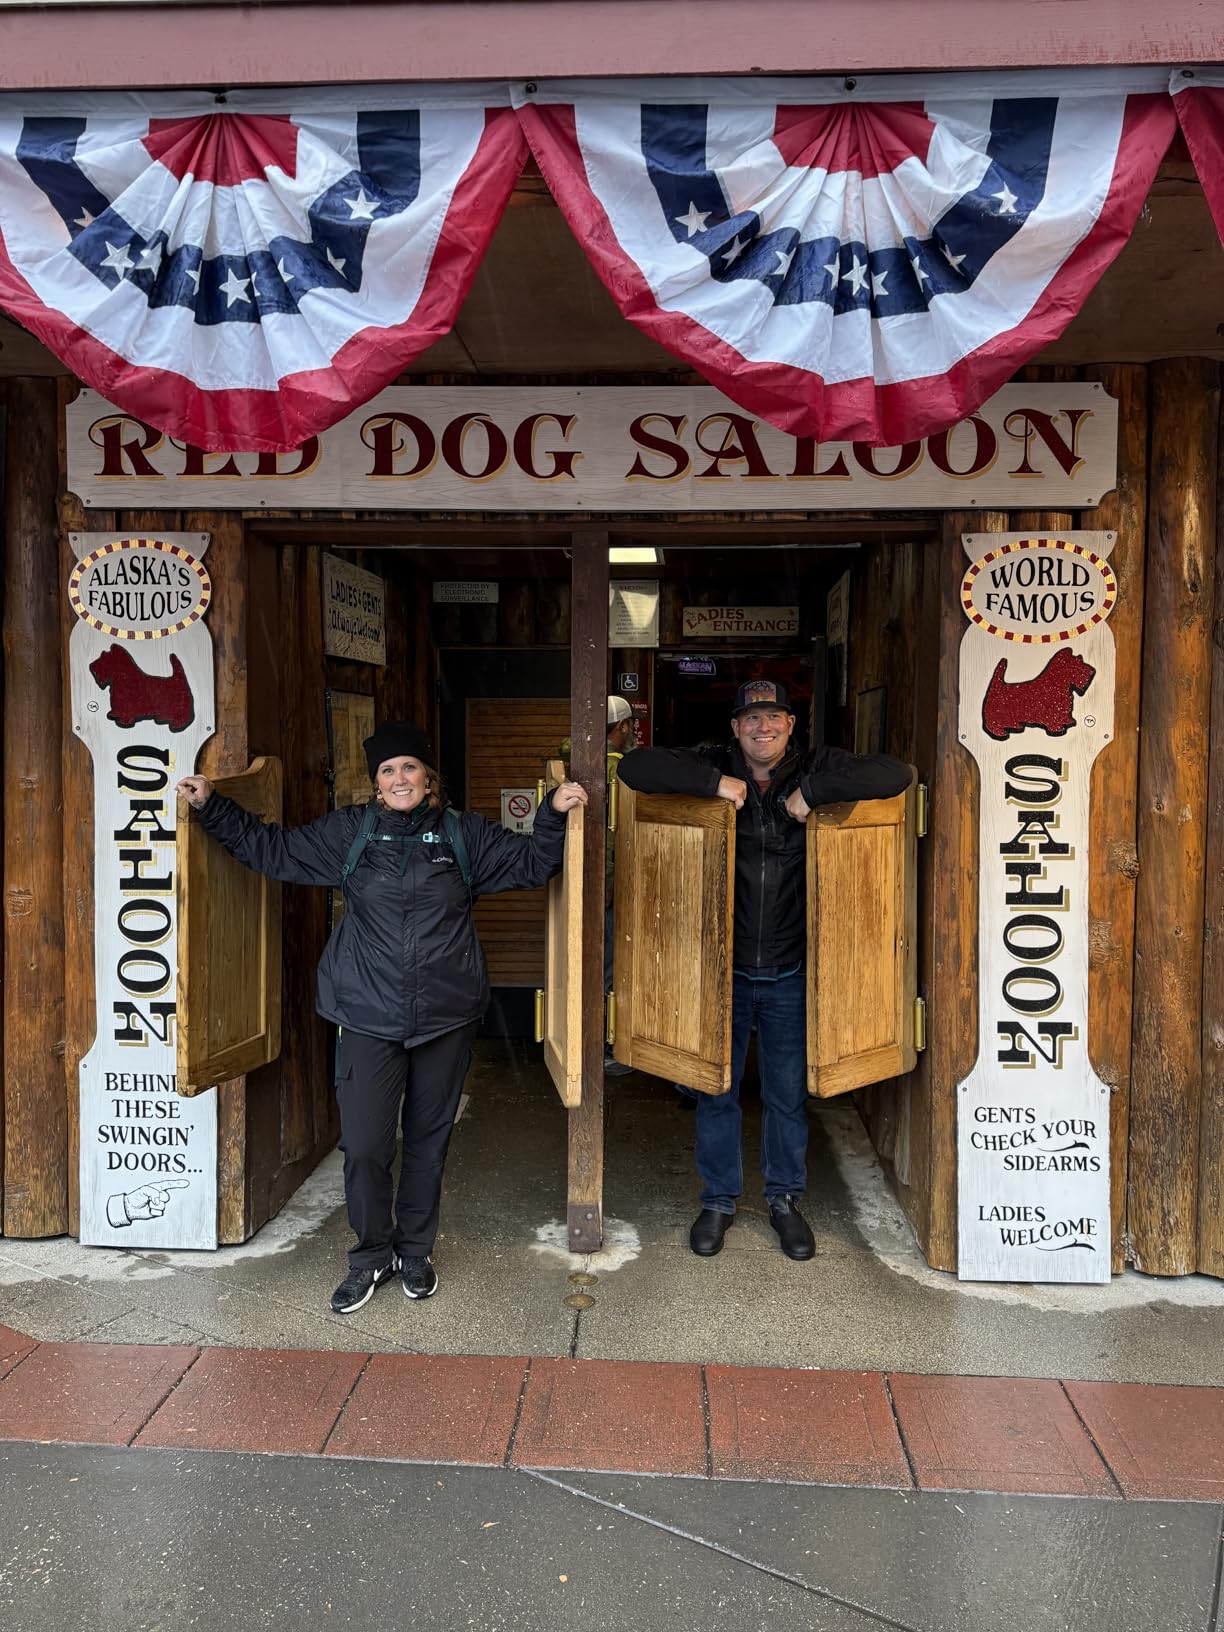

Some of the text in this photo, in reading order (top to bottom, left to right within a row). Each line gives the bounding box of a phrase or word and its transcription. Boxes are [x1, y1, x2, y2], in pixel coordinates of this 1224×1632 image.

[360, 411, 585, 484] DOG
[89, 555, 191, 587] ALASKA'S
[990, 556, 1090, 589] WORLD
[88, 590, 192, 621] FABULOUS
[330, 576, 358, 608] LADIES
[362, 591, 382, 617] GENTS
[986, 591, 1095, 624] FAMOUS
[686, 608, 745, 630] LADIES
[713, 620, 798, 632] ENTRANCE
[113, 744, 177, 1047] SALOON
[997, 754, 1079, 1070] SALOON
[112, 1099, 181, 1119] THESE
[974, 1106, 1036, 1124] GENTS
[97, 1124, 195, 1146] SWINGIN'
[971, 1119, 1097, 1151] CHECK YOUR
[107, 1151, 203, 1174] DOORS...
[1003, 1154, 1101, 1172] SIDEARMS
[978, 1205, 1046, 1222] LADIES
[1000, 1217, 1098, 1246] WELCOME
